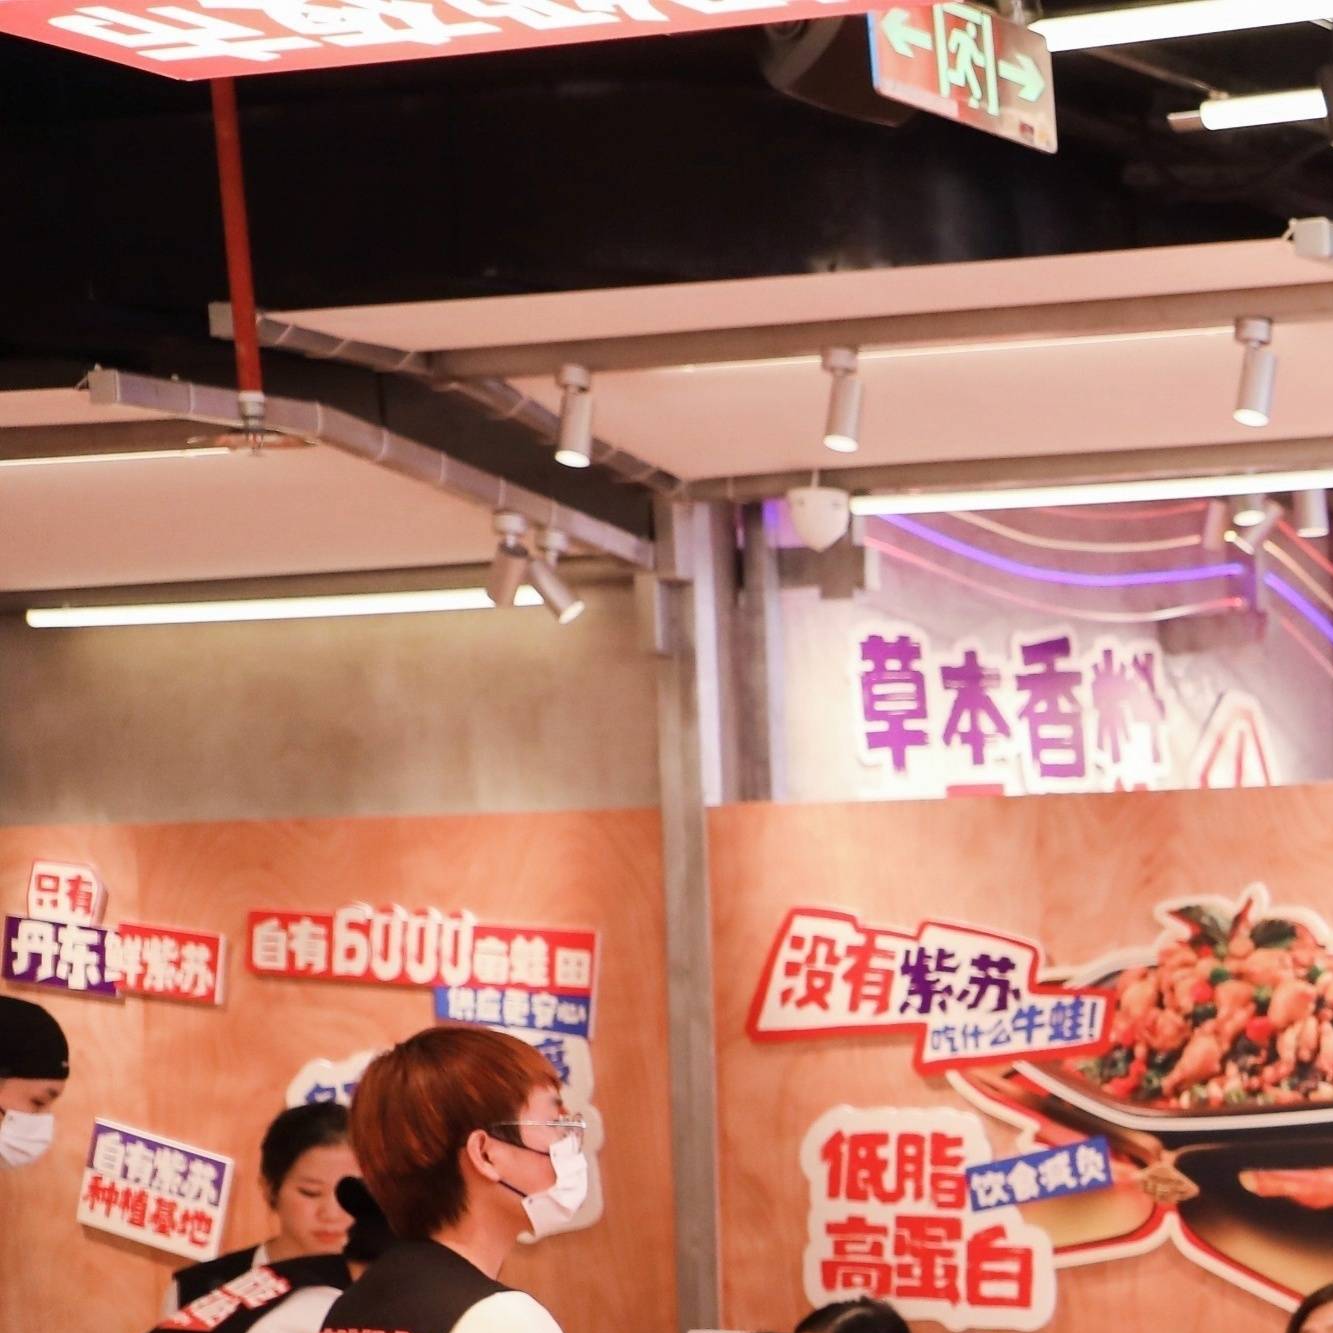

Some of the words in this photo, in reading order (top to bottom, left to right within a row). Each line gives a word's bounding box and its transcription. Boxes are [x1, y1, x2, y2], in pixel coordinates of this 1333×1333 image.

[36, 874, 94, 915] 只有
[11, 918, 215, 998] 丹东鲜紫苏
[778, 932, 1022, 1016] 没有紫苏
[929, 996, 1099, 1053] 吃什么牛蛙!
[93, 1131, 222, 1207] 自有紫苏
[821, 1128, 967, 1207] 低脂
[84, 1173, 213, 1247] 种植基地
[821, 1216, 1033, 1311] 高蛋白
